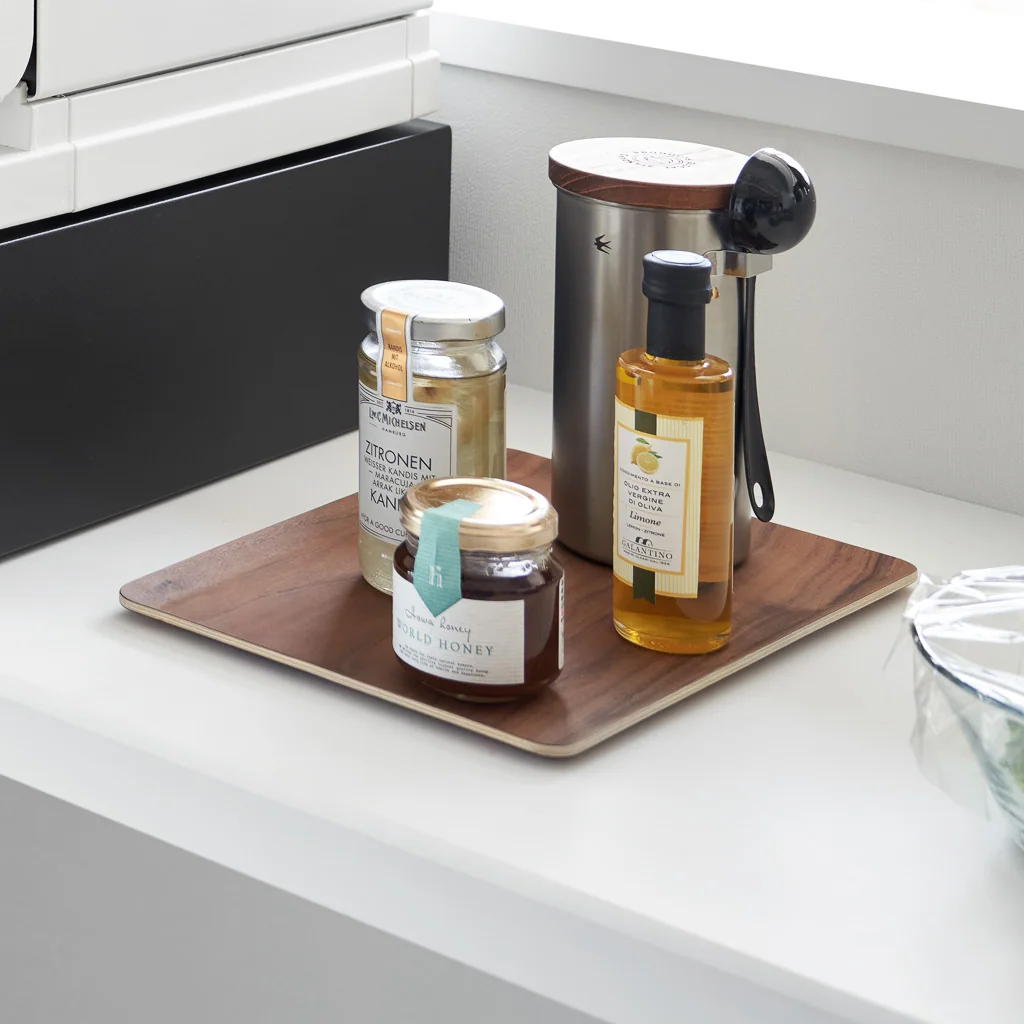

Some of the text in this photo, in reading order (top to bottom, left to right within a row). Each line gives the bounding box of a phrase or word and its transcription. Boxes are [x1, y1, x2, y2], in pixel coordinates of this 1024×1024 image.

[385, 361, 404, 372] ALKOHOL
[382, 427, 406, 437] HAMBURG
[365, 439, 432, 471] ZITRONEN
[364, 455, 386, 472] WEISSER
[388, 466, 418, 481] KANDIS
[619, 467, 649, 482] CONDIMENTO
[372, 479, 393, 493] ARRAK
[375, 471, 414, 489] MARACUJA
[623, 480, 671, 498] OLIO EXTRA
[370, 488, 400, 511] KAN
[628, 490, 664, 505] VERGINE
[637, 501, 663, 512] OLIVA
[629, 510, 662, 526] Limone
[374, 521, 394, 534] GOOD
[626, 522, 641, 532] LEMON
[644, 529, 666, 537] ZITRONE
[621, 539, 673, 560] GALANTINO
[396, 617, 432, 644] WORLD
[439, 638, 493, 656] HONEY
[440, 616, 471, 643] honey
